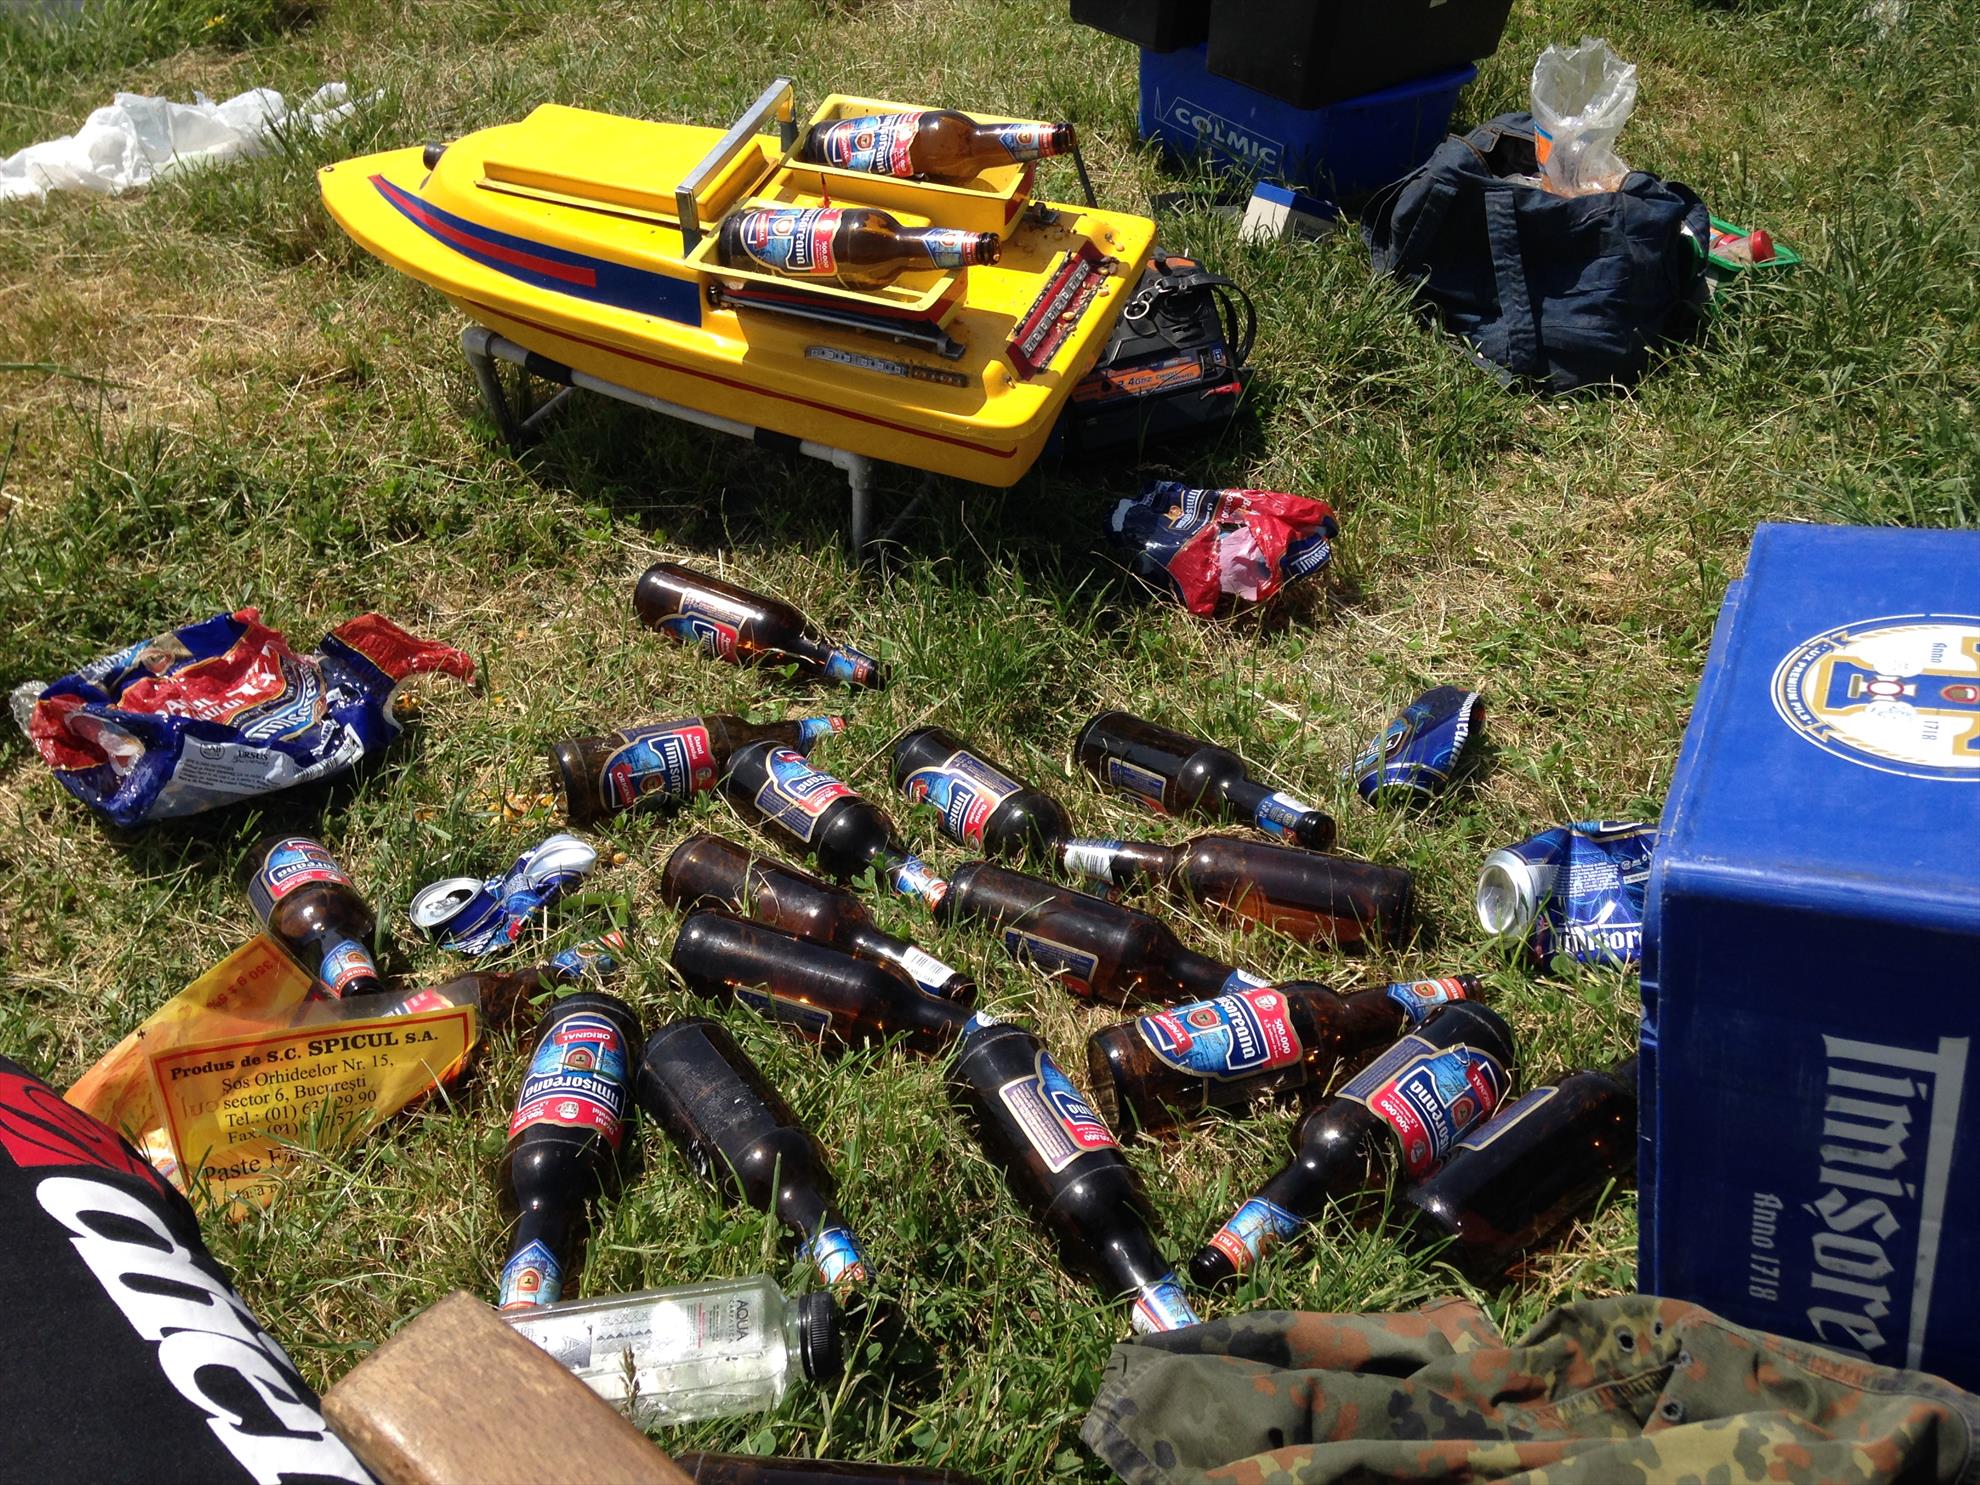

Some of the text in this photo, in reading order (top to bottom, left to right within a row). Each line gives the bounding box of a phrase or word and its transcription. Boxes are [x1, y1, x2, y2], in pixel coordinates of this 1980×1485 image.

[1175, 107, 1277, 166] COLMIC
[1930, 642, 1948, 664] Anno
[1786, 661, 1808, 701] PREMIUM
[1791, 701, 1809, 724] PILS
[1921, 720, 1940, 742] 1718
[238, 750, 269, 761] URSUS
[663, 738, 683, 795] Timisore
[562, 1031, 611, 1042] ORIGINAL
[1273, 1018, 1291, 1055] 500.000
[170, 1030, 438, 1081] Produs de S.C. SPICUL S.A.
[255, 1063, 338, 1087] Orhideelor
[341, 1058, 366, 1073] Nr.
[373, 1053, 394, 1068] 15,
[223, 1094, 270, 1110] sector
[274, 1088, 290, 1103] 6,
[225, 1112, 260, 1128] Tel.:
[265, 1104, 297, 1123] (01)
[1380, 1099, 1411, 1134] 500.000
[1748, 1191, 1784, 1302] Anno 1718
[736, 1299, 750, 1342] AQUA
